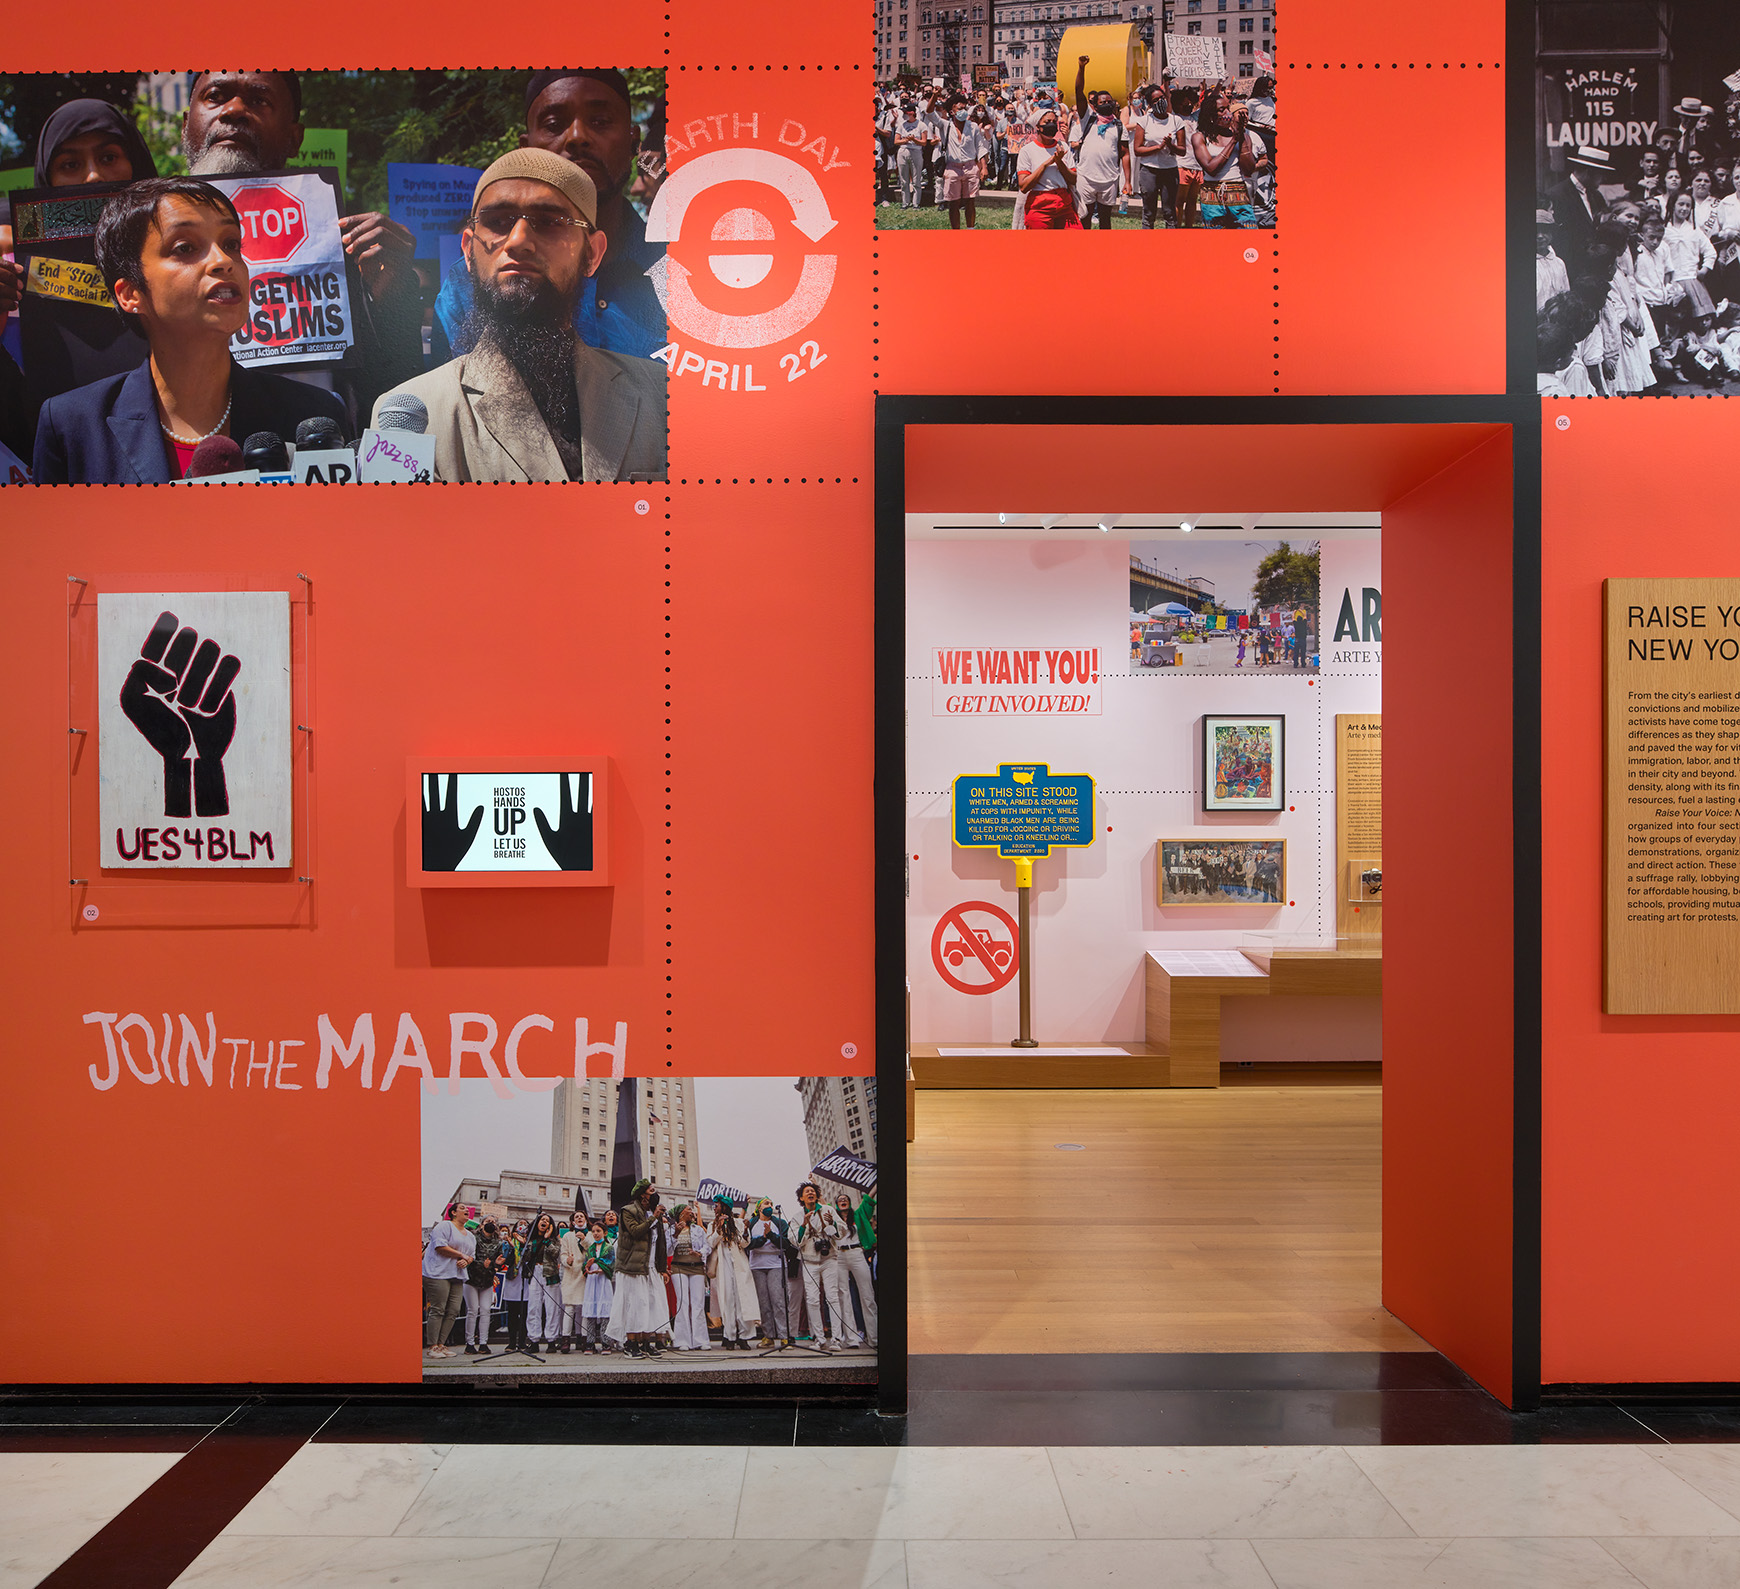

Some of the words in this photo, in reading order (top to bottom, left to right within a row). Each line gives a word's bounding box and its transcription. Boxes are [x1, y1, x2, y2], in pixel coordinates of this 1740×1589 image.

[1174, 36, 1201, 47] TRANS
[1175, 46, 1203, 56] QUEER
[1565, 70, 1638, 92] HARLEM
[1584, 87, 1619, 97] HAND
[1586, 101, 1615, 116] 115
[1547, 121, 1658, 147] LAUNDRY
[637, 112, 759, 180] EARTH
[778, 118, 851, 172] DAY
[311, 148, 335, 160] with
[444, 192, 471, 203] ZERO
[38, 262, 60, 279] End
[43, 280, 65, 296] Stop
[67, 284, 97, 301] Racial
[229, 303, 345, 346] USLIMS
[257, 347, 279, 358] Action
[280, 344, 303, 355] Center
[306, 341, 347, 353] iacenter.org
[650, 341, 766, 392] APRIL
[779, 340, 828, 383] 22
[1333, 587, 1382, 642] AR
[1628, 606, 1706, 628] RAISE
[1628, 639, 1693, 661] NEW
[1332, 651, 1371, 663] ARTE
[937, 650, 972, 684] WE
[976, 650, 1040, 685] WANT
[1044, 648, 1099, 685] YOU!
[1628, 691, 1652, 700] From
[1654, 691, 1669, 700] the
[1671, 691, 1696, 702] city's
[1698, 691, 1732, 700] earliest
[946, 695, 987, 713] GET
[987, 695, 1091, 713] INVOLVED!
[1628, 704, 1681, 713] convictions
[1683, 704, 1700, 713] and
[1628, 718, 1666, 726] activists
[1669, 718, 1691, 726] have
[1628, 731, 1680, 739] differences
[1695, 731, 1715, 740] they
[1628, 744, 1645, 752] and
[1647, 744, 1675, 753] paved
[1678, 744, 1693, 752] the
[1715, 744, 1729, 752] for
[1628, 757, 1684, 767] immigration,
[1686, 757, 1712, 766] labor,
[1713, 757, 1731, 765] and
[1628, 770, 1636, 778] in
[1639, 770, 1660, 778] their
[1662, 770, 1679, 779] city
[1681, 770, 1698, 778] and
[1700, 770, 1737, 779] beyond.
[494, 787, 526, 796] HOSTOS
[970, 787, 985, 798] ON
[989, 787, 1013, 798] THIS
[1015, 787, 1039, 797] SITE
[1042, 786, 1077, 797] STOOD
[1628, 783, 1663, 793] density,
[1665, 783, 1691, 793] along
[1693, 783, 1712, 791] with
[1714, 783, 1726, 791] its
[494, 797, 526, 807] HANDS
[1678, 796, 1695, 804] fuel
[1705, 796, 1736, 805] lasting
[1057, 807, 1078, 815] WHILE
[1655, 808, 1680, 817] Raise
[1682, 808, 1702, 817] Your
[1704, 808, 1732, 817] Voice:
[494, 808, 526, 835] UP
[967, 817, 999, 825] UNARMED
[1627, 822, 1673, 832] organized
[1676, 822, 1695, 830] into
[1697, 822, 1716, 830] four
[116, 826, 275, 862] UES4BLM
[494, 838, 511, 849] LET
[513, 838, 526, 849] US
[1627, 835, 1647, 843] how
[1649, 837, 1681, 845] groups
[1683, 835, 1693, 843] of
[1695, 835, 1737, 844] everyday
[494, 850, 526, 858] BREATHE
[1627, 848, 1702, 857] demonstrations,
[1627, 861, 1645, 869] and
[1647, 861, 1673, 869] direct
[1676, 861, 1706, 869] action.
[1709, 861, 1737, 869] These
[1636, 874, 1674, 884] suffrage
[1677, 874, 1698, 884] rally,
[1700, 874, 1740, 884] lobbying
[1627, 887, 1641, 895] for
[1643, 887, 1690, 895] affordable
[1692, 887, 1730, 897] housing,
[1627, 900, 1665, 909] schools,
[1667, 900, 1710, 910] providing
[1627, 913, 1665, 923] creating
[1667, 913, 1680, 921] art
[1682, 913, 1695, 921] for
[1698, 913, 1738, 923] protests,
[82, 1011, 216, 1091] JOIN
[221, 1036, 305, 1090] THE
[315, 1011, 628, 1099] MARCH
